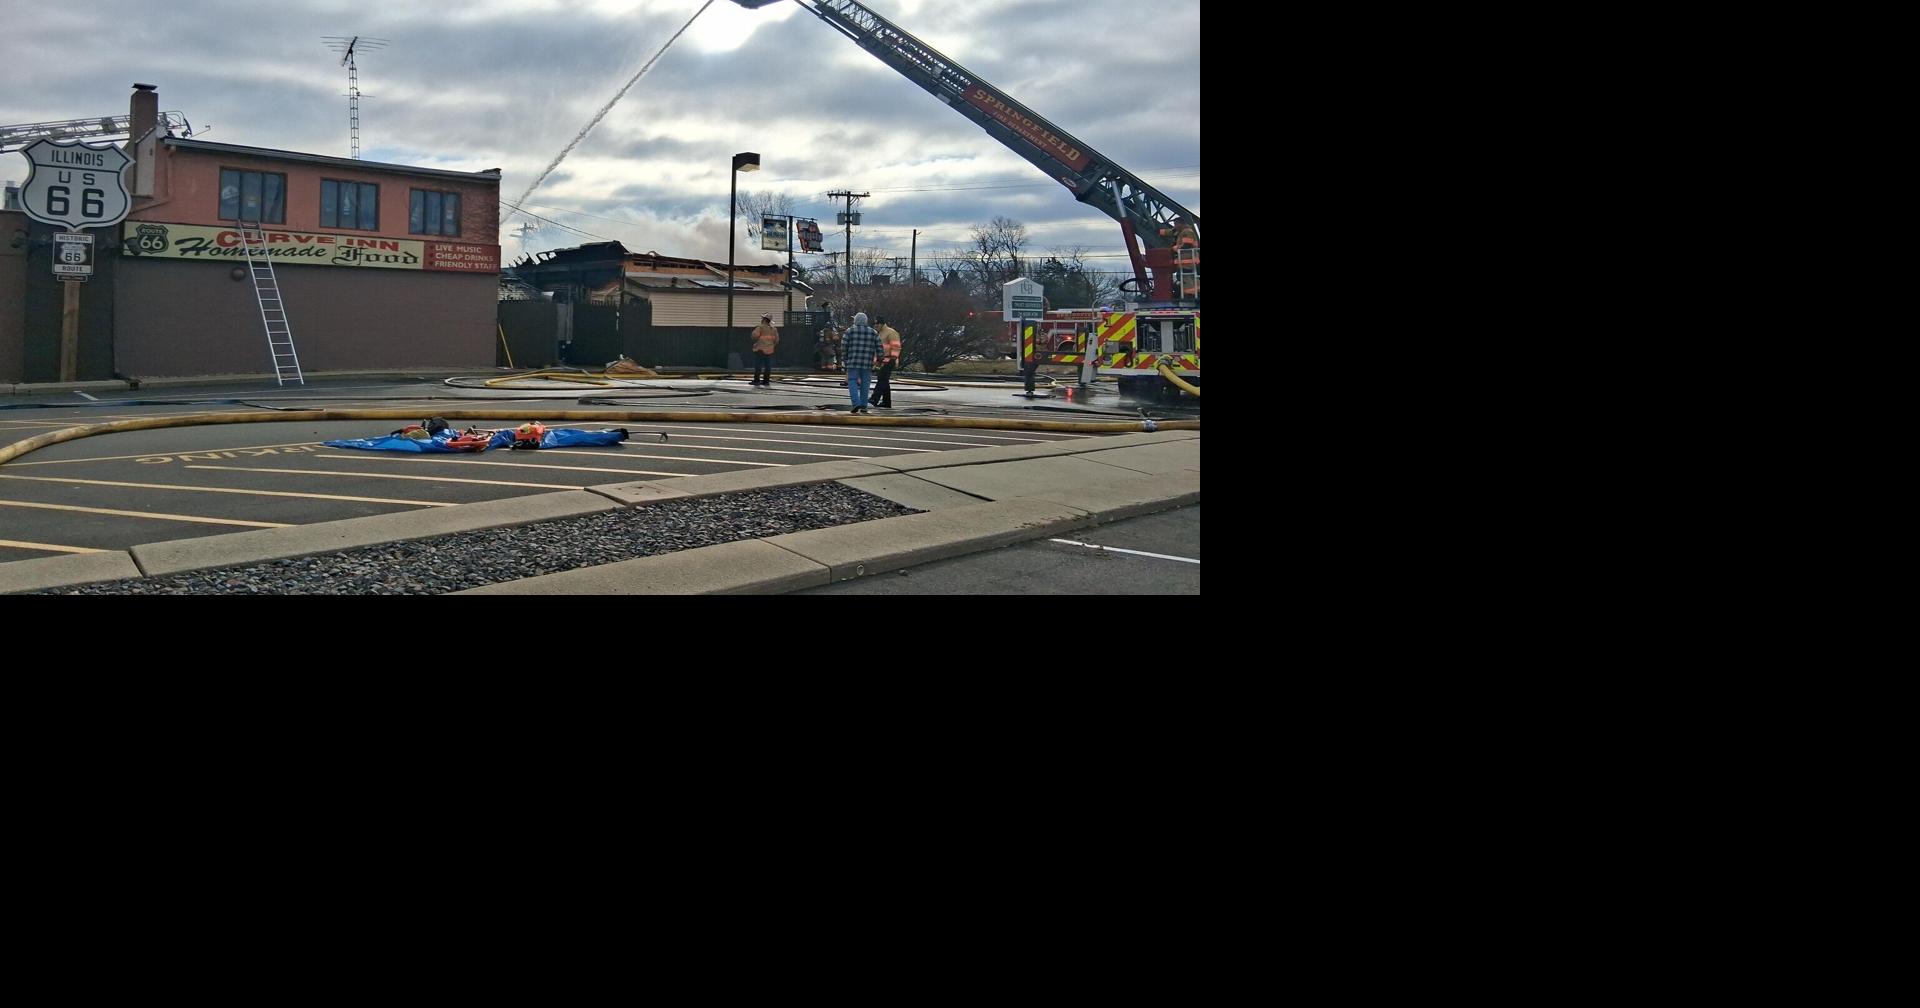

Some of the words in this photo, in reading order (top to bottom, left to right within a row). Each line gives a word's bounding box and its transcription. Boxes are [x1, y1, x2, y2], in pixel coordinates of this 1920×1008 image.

[973, 89, 1081, 161] SPRINGFIELD
[51, 149, 104, 167] ILLINOIS
[46, 185, 104, 218] 66
[140, 235, 163, 249] 66
[216, 230, 335, 247] CURVE
[346, 238, 400, 252] INN
[435, 244, 453, 252] LIVE
[456, 246, 482, 254] MUSIC
[65, 252, 81, 262] 66
[175, 237, 327, 257] Homemade
[332, 245, 419, 265] Food
[435, 252, 463, 260] CHEAP
[464, 254, 494, 262] DRINKS
[434, 260, 473, 269] FRIENDLY
[474, 262, 498, 270] STAFF
